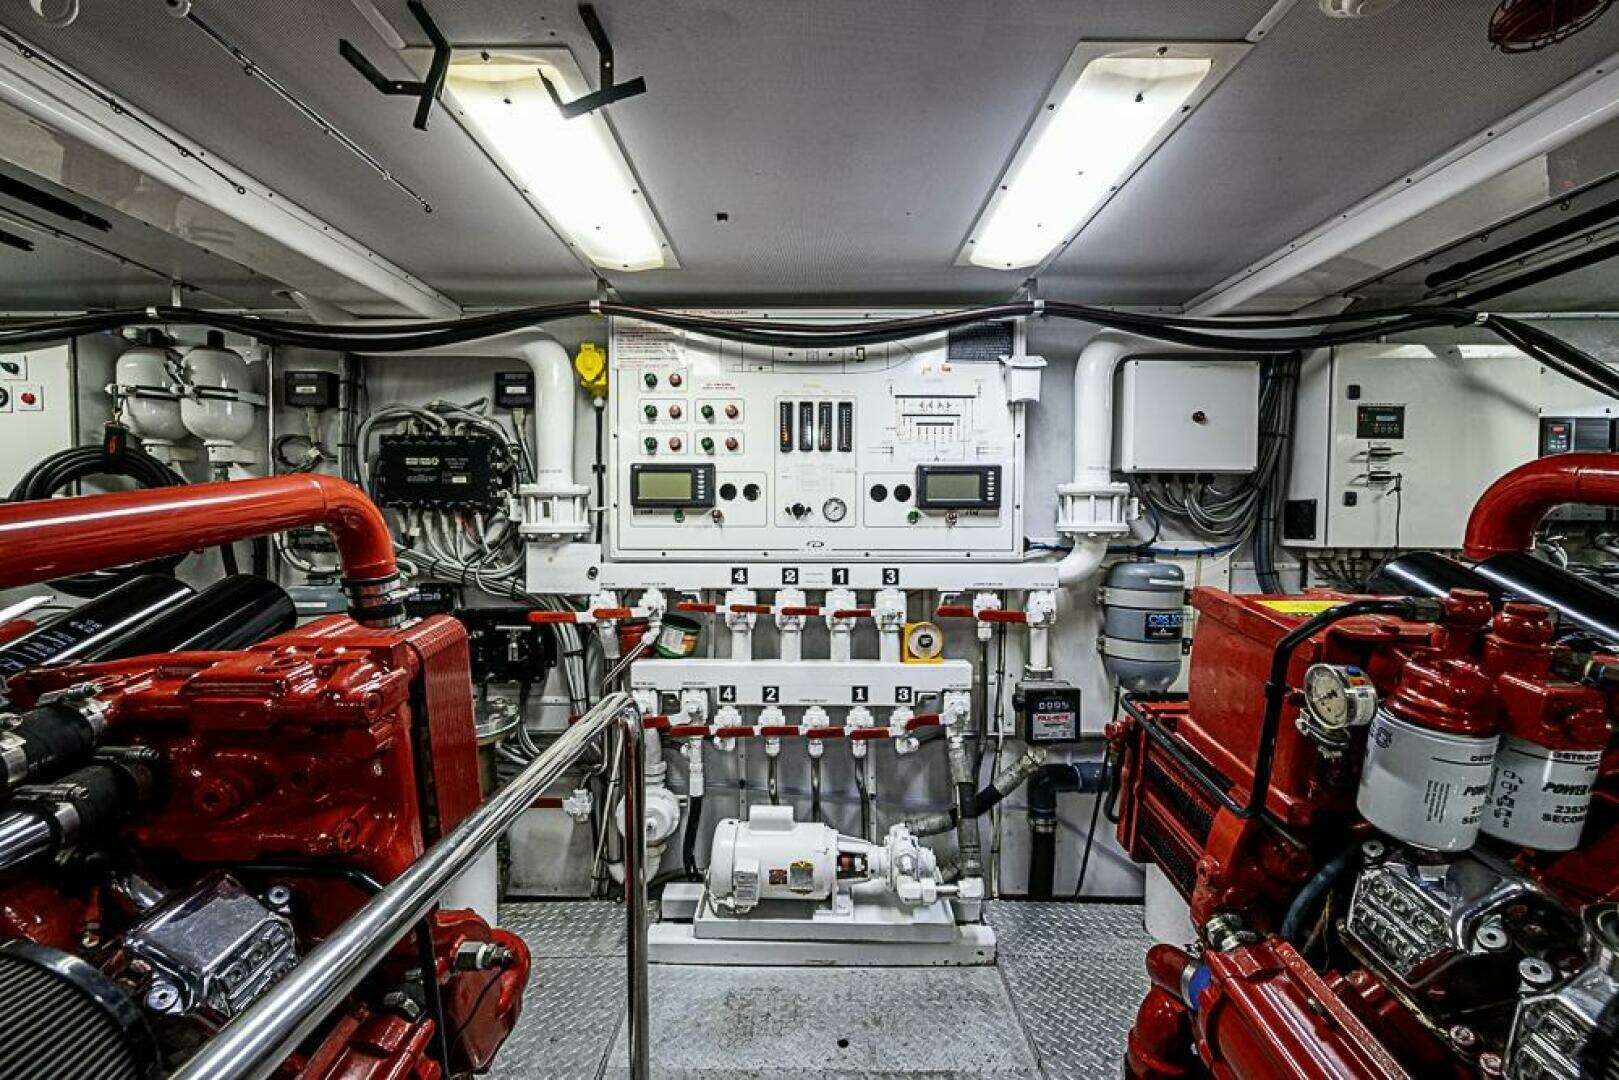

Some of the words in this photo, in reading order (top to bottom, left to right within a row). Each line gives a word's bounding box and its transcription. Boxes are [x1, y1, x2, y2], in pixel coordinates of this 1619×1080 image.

[734, 569, 745, 582] 4
[785, 570, 795, 582] 2
[886, 570, 896, 583] 3
[723, 688, 733, 699] 4
[766, 688, 776, 699] 2
[898, 688, 909, 699] 3
